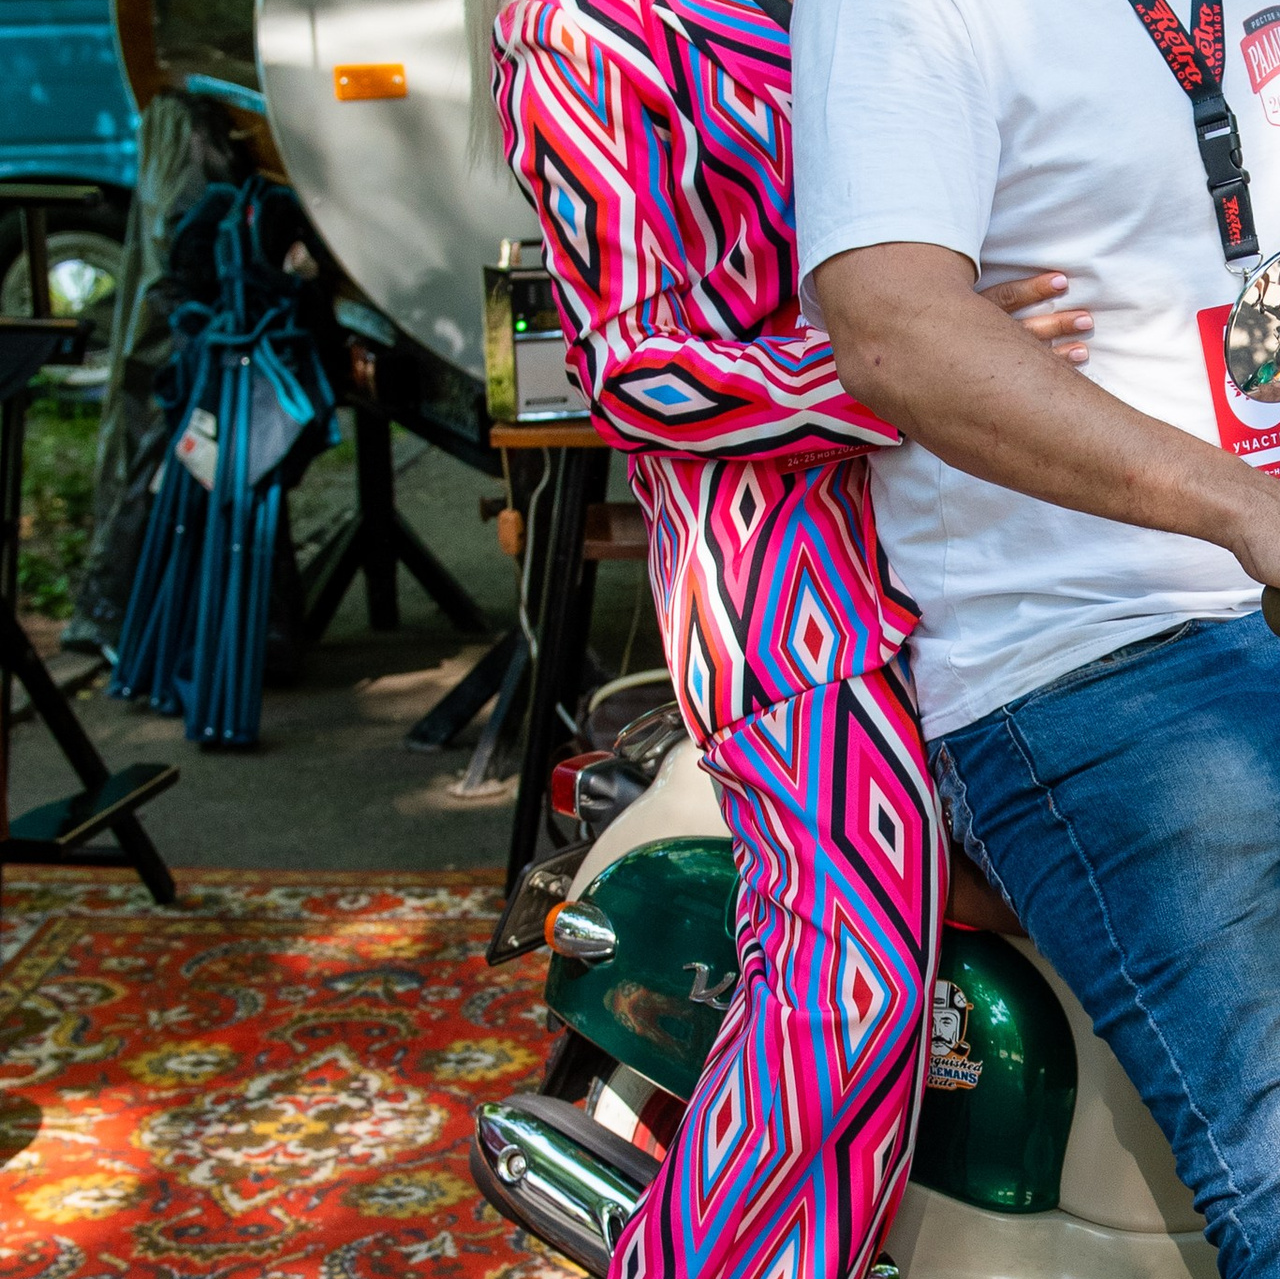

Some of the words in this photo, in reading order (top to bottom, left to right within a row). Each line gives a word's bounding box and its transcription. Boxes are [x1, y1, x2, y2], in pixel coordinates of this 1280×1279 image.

[1212, 4, 1222, 38] SHOW
[1135, 4, 1168, 50] MOTOR
[1166, 53, 1194, 90] SHOW
[787, 452, 816, 467] 24-25
[930, 1065, 978, 1085] LEMANS
